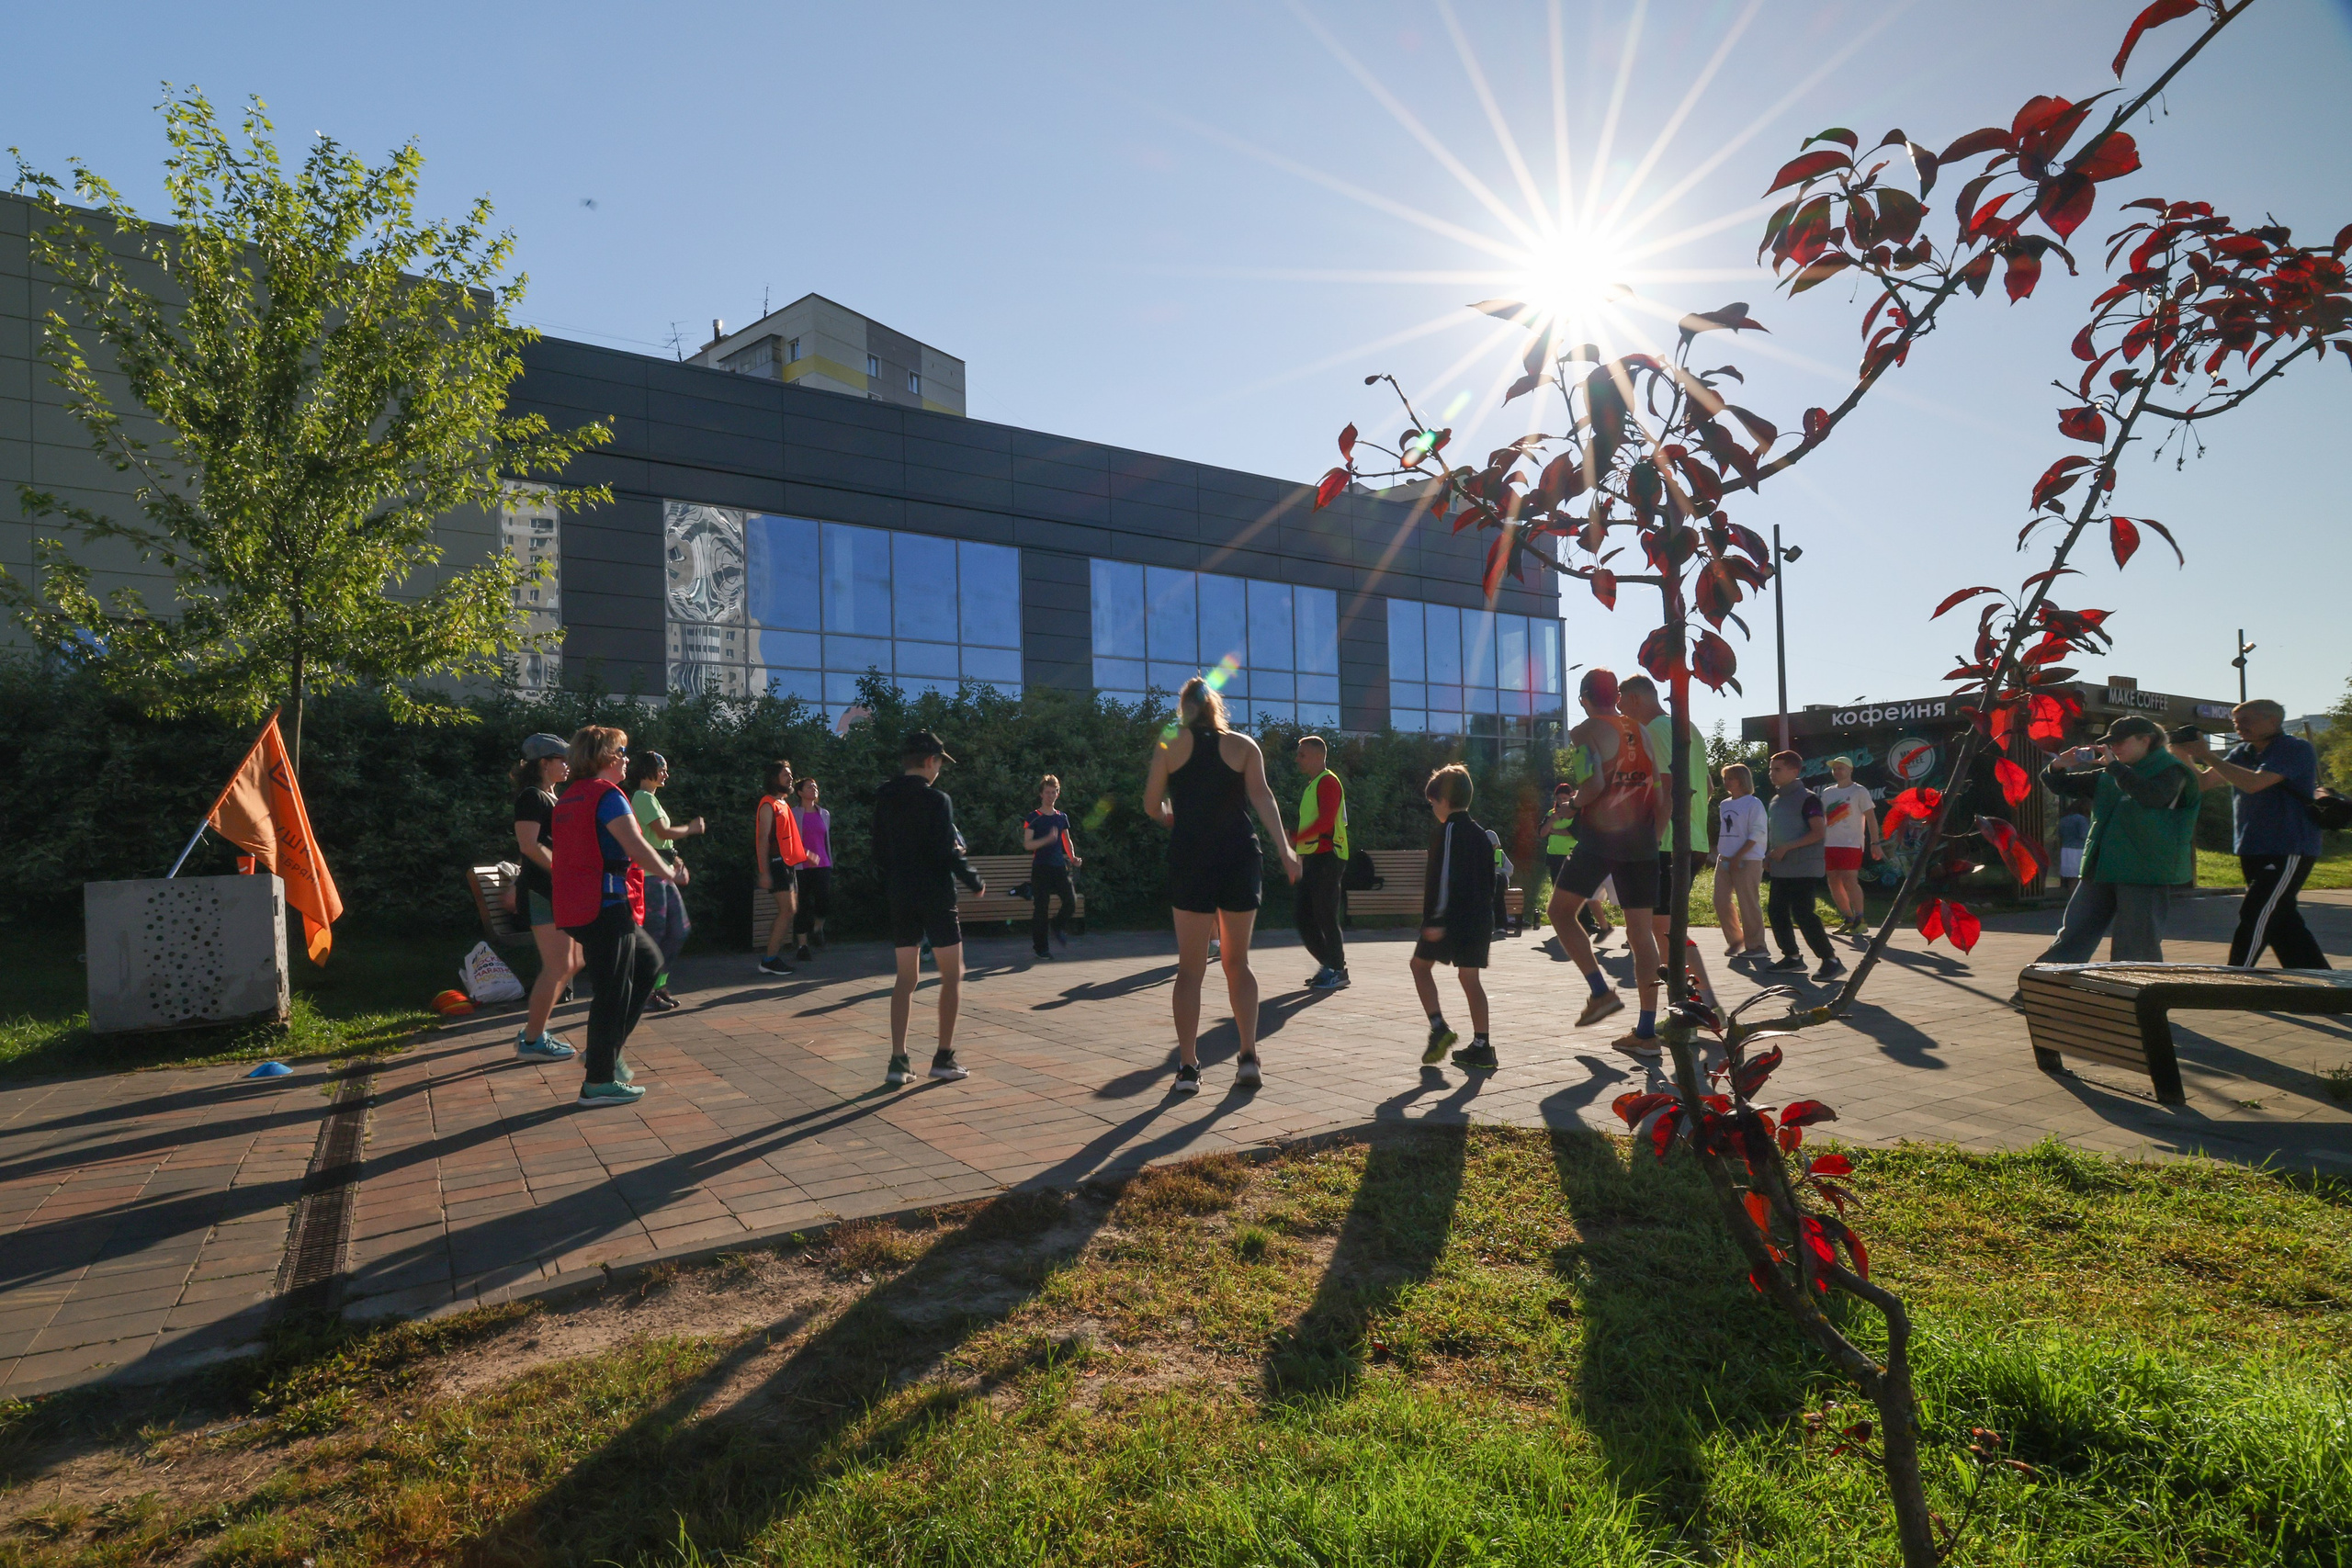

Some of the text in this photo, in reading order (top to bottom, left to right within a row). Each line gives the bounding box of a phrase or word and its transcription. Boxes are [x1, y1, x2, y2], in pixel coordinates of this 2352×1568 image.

[2109, 688, 2168, 711] MAKE COFFEE
[1832, 702, 1946, 727] кофейня
